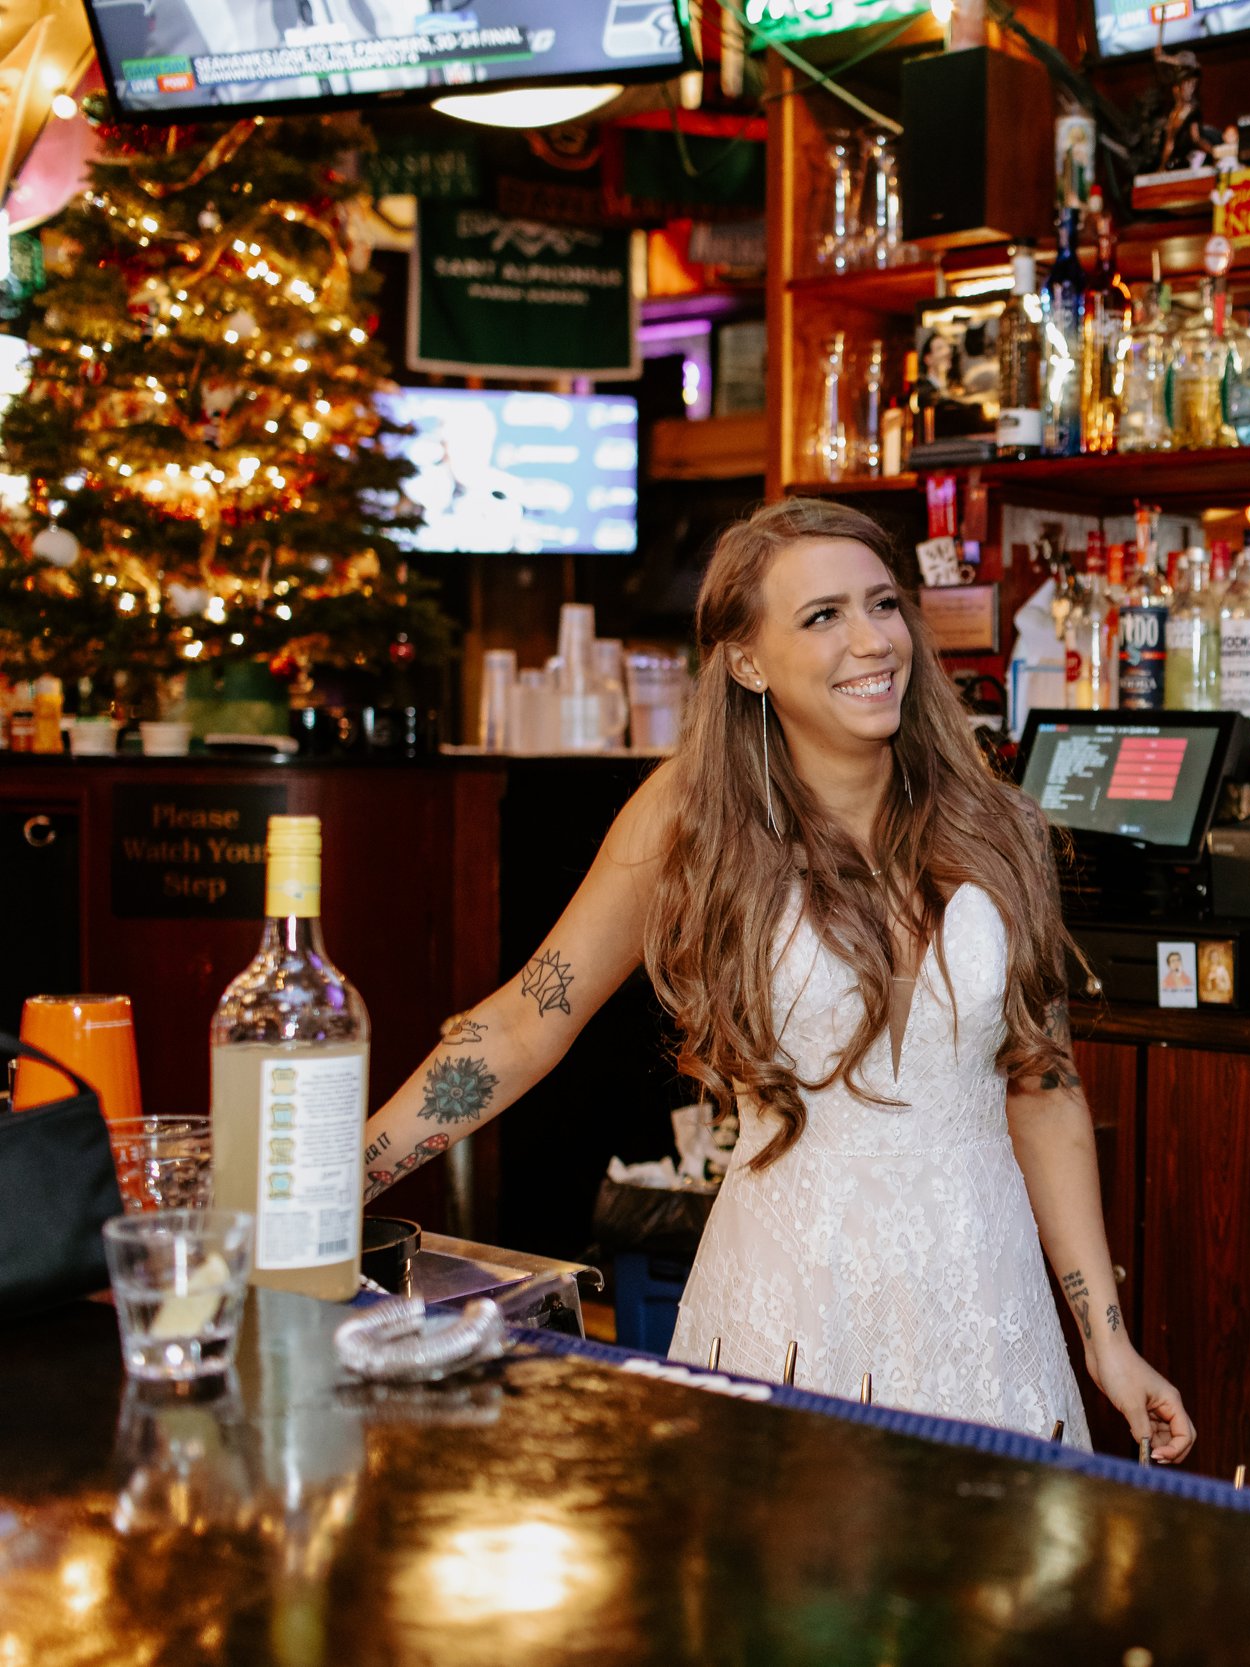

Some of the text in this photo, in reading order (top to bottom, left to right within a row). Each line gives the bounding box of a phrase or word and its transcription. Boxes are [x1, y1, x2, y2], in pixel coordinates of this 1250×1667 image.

[152, 802, 240, 829] Please
[122, 836, 200, 863] Watch
[164, 873, 227, 903] Step
[377, 1131, 392, 1150] IT
